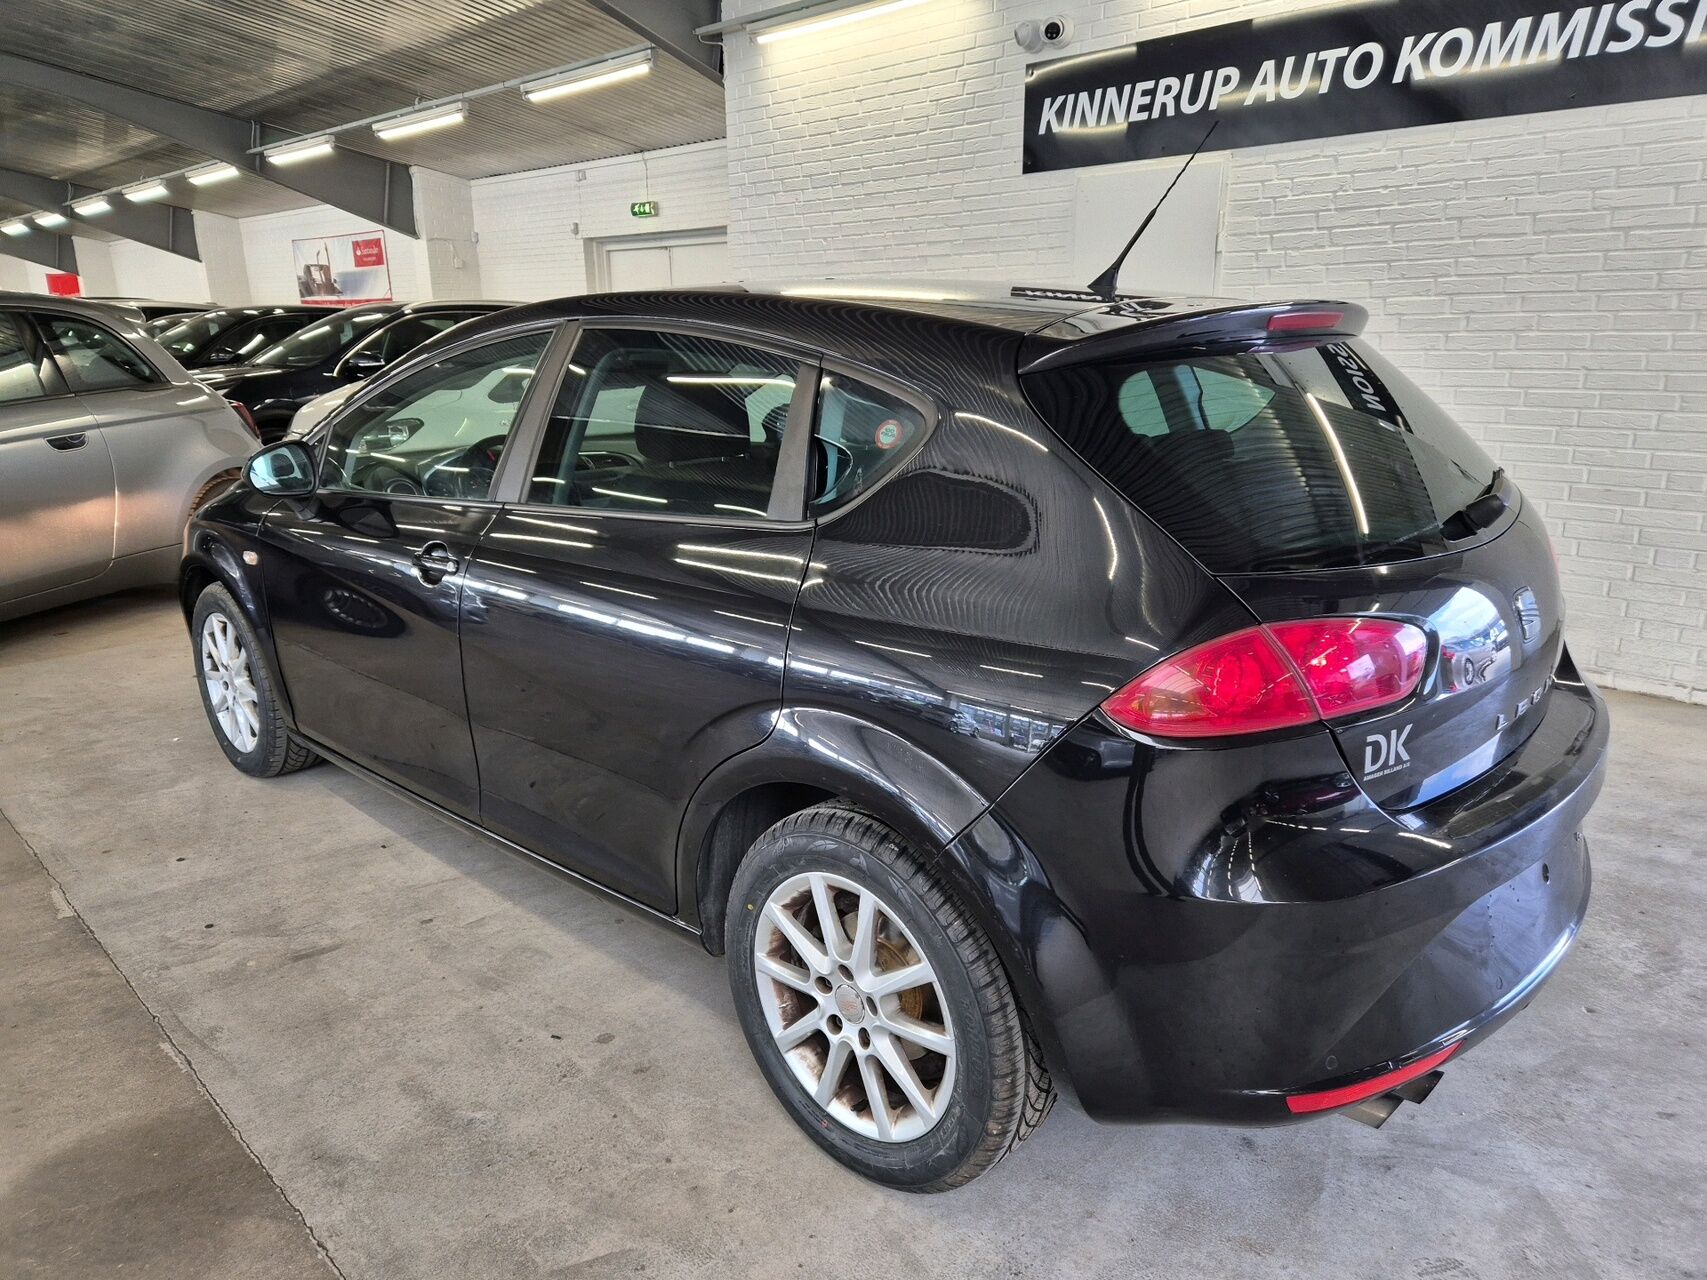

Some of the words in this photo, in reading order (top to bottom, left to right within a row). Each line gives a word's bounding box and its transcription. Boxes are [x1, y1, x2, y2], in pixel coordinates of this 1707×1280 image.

[1038, 66, 1240, 135] KINNERUP
[1243, 41, 1384, 106] AUTO
[1364, 723, 1413, 774] DK
